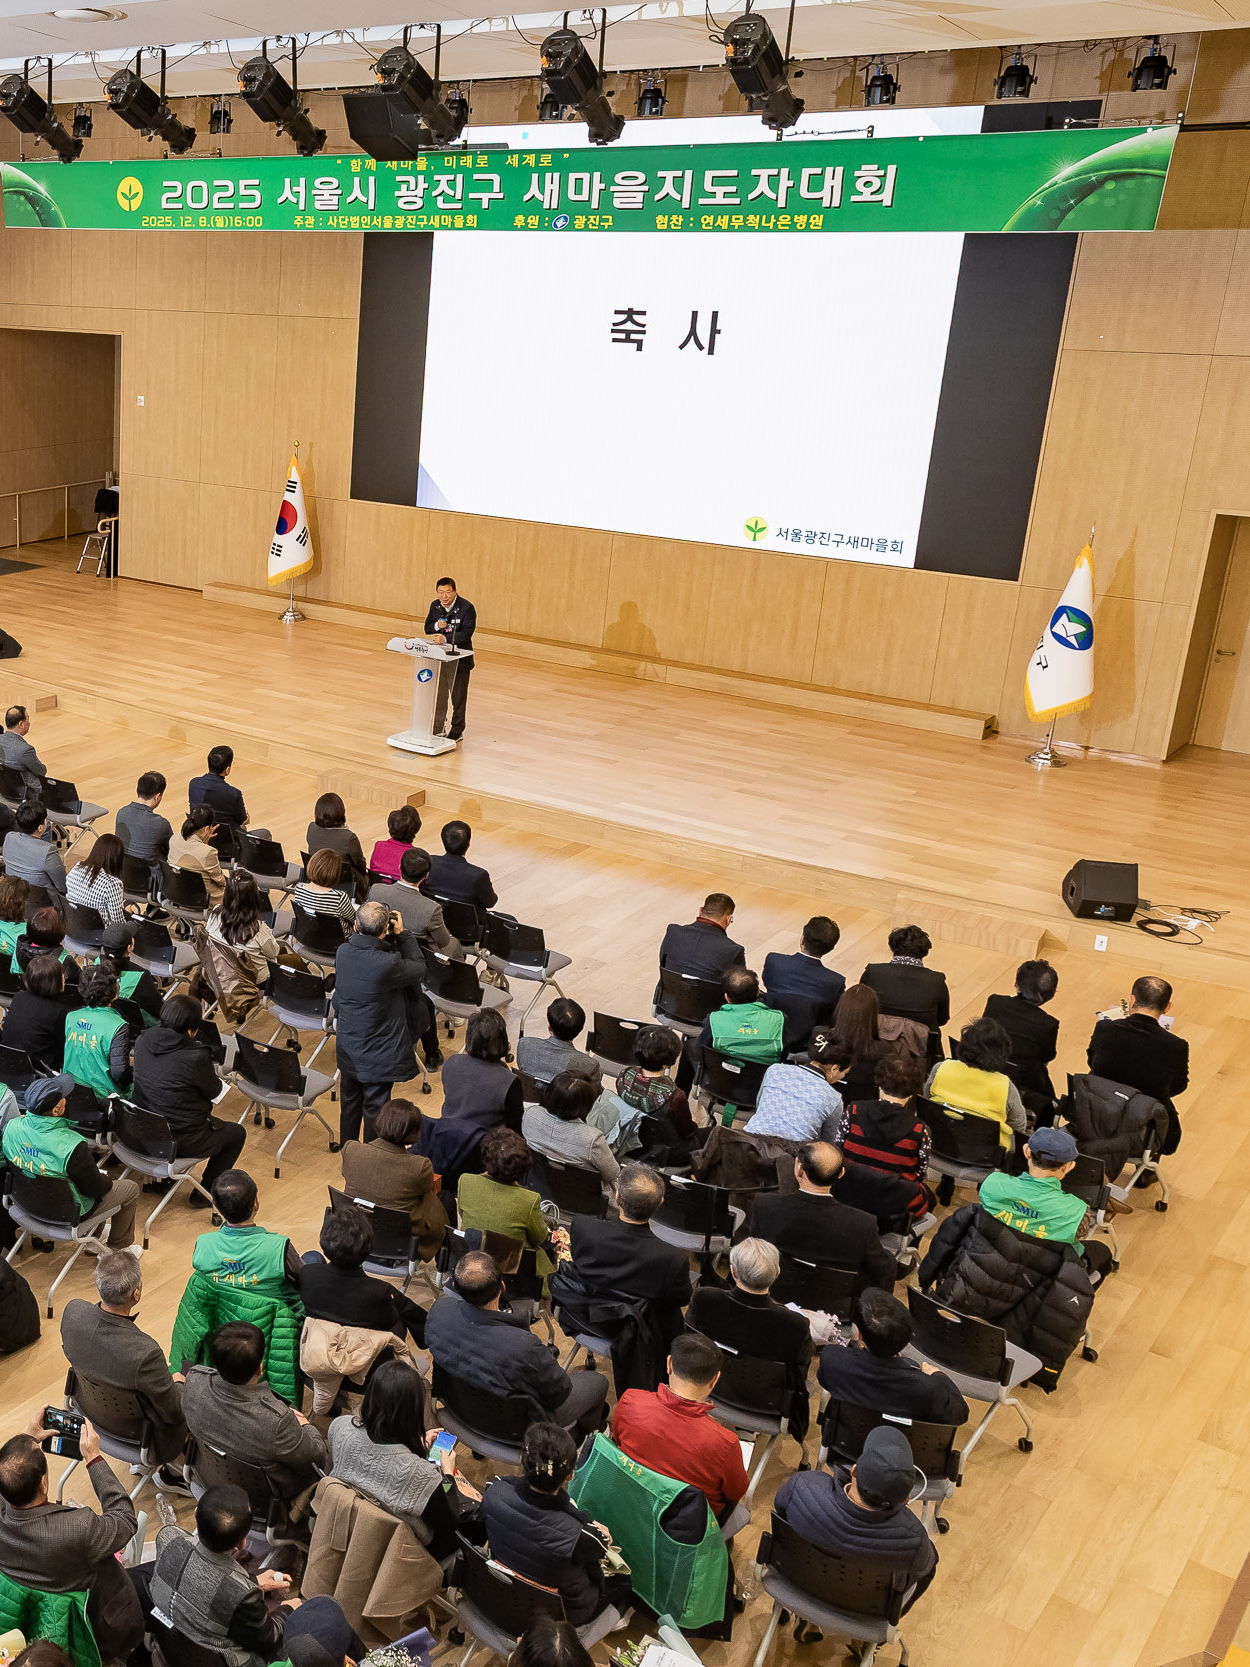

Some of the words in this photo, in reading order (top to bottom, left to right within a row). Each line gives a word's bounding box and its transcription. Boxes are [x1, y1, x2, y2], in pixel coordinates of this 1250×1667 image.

[350, 158, 377, 172] 함께
[444, 155, 490, 169] 미래로
[505, 153, 553, 168] 세계로
[161, 178, 263, 210] 2025
[277, 175, 378, 211] 서울시
[393, 172, 505, 212] 광진구
[523, 164, 898, 210] 새마을지도자대회
[141, 215, 176, 228] 2025.
[179, 215, 196, 228] 12.
[199, 215, 264, 228] 8.(월)16:00
[293, 215, 316, 229] 주관
[327, 214, 478, 229] 사단법인서울광진구새마을회
[513, 214, 540, 228] 후원
[573, 215, 614, 229] 광진구
[656, 214, 684, 229] 협찬
[700, 214, 824, 230] 연세무척나은병원
[611, 307, 647, 352] 축
[678, 310, 721, 356] 사
[776, 527, 904, 554] 서울광진구새마을회
[19, 1145, 39, 1159] SMU
[1012, 1201, 1039, 1219] SMU
[993, 1210, 1048, 1239] 새마을
[221, 1260, 246, 1271] SMU
